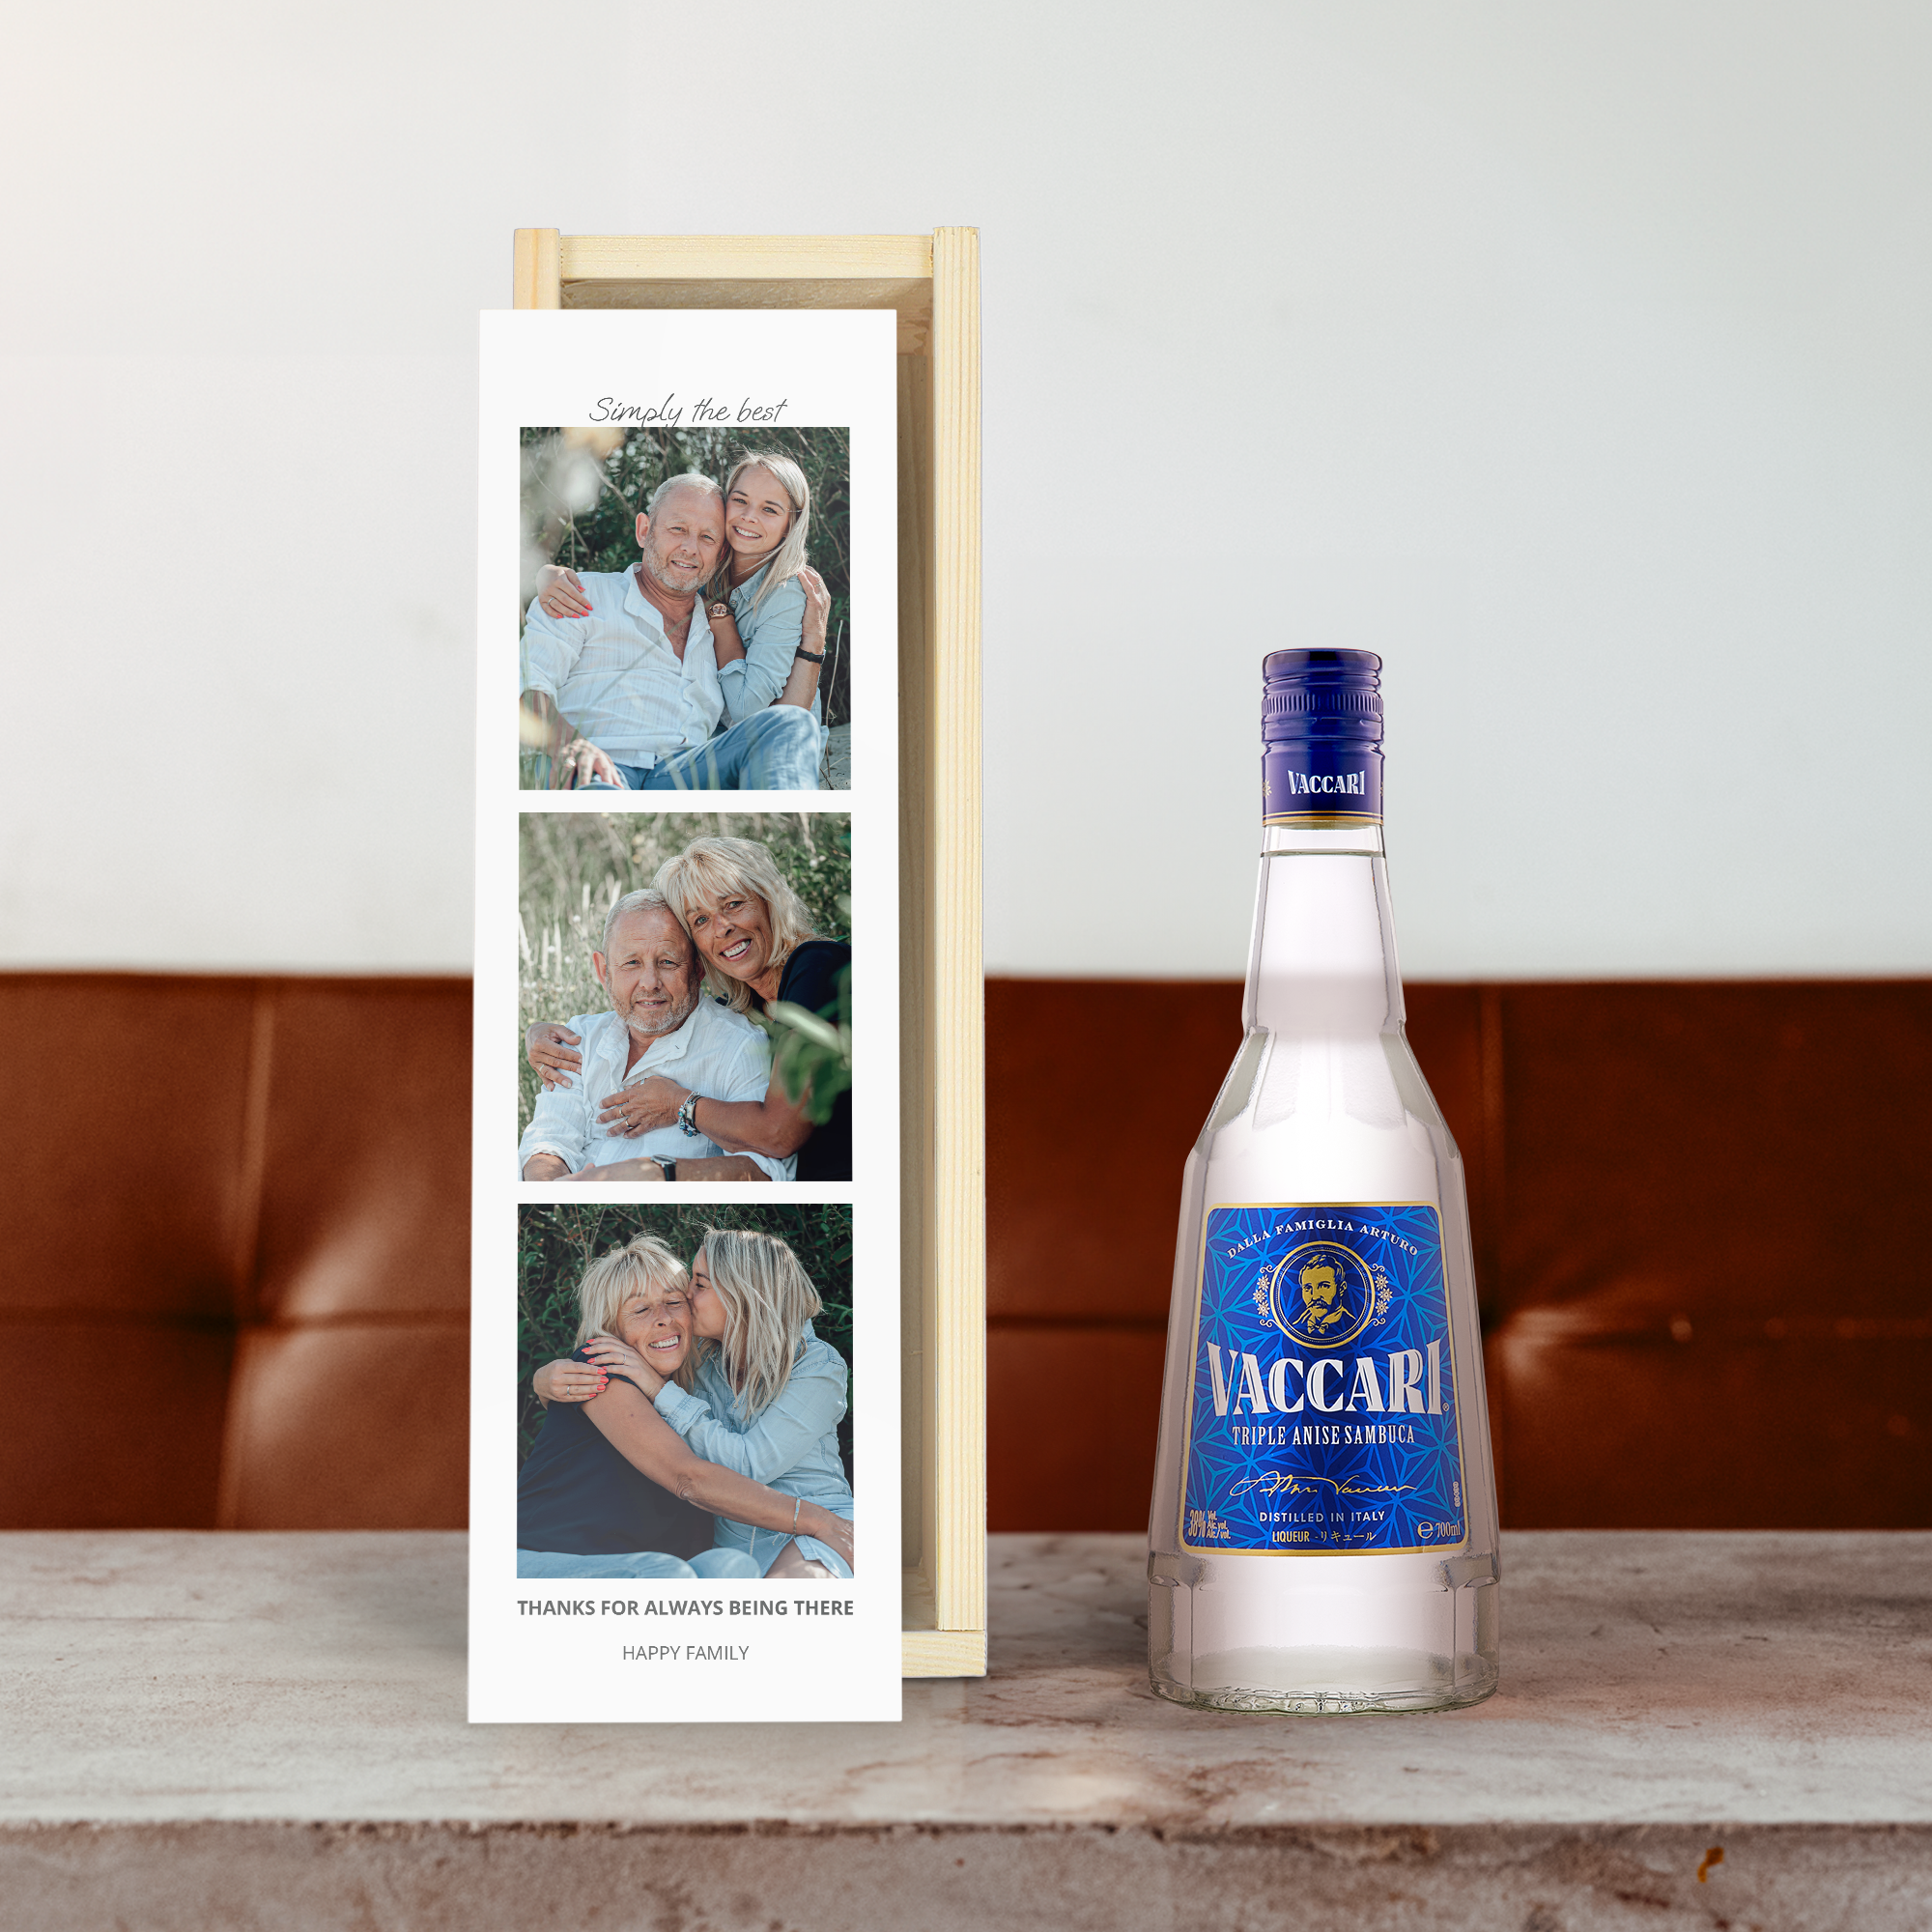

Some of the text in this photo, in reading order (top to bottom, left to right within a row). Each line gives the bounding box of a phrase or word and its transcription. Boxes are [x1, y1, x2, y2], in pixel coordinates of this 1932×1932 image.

[588, 392, 787, 427] Simply the best
[1288, 770, 1365, 795] VACCARI
[1227, 1219, 1418, 1259] DALLA FAMIGLIA ARTURO
[1207, 1338, 1442, 1416] VACCARI
[1232, 1425, 1415, 1446] TRIPLE ANISE SAMBUCA
[1188, 1509, 1207, 1538] 38%
[1259, 1511, 1385, 1522] DISTILLED IN ITALY
[1272, 1531, 1310, 1543] LIQUEUR
[1435, 1520, 1461, 1538] 700ml
[517, 1601, 854, 1616] THANKS FOR ALWAYS BEING THERE
[623, 1645, 750, 1661] HAPPY FAMILY
